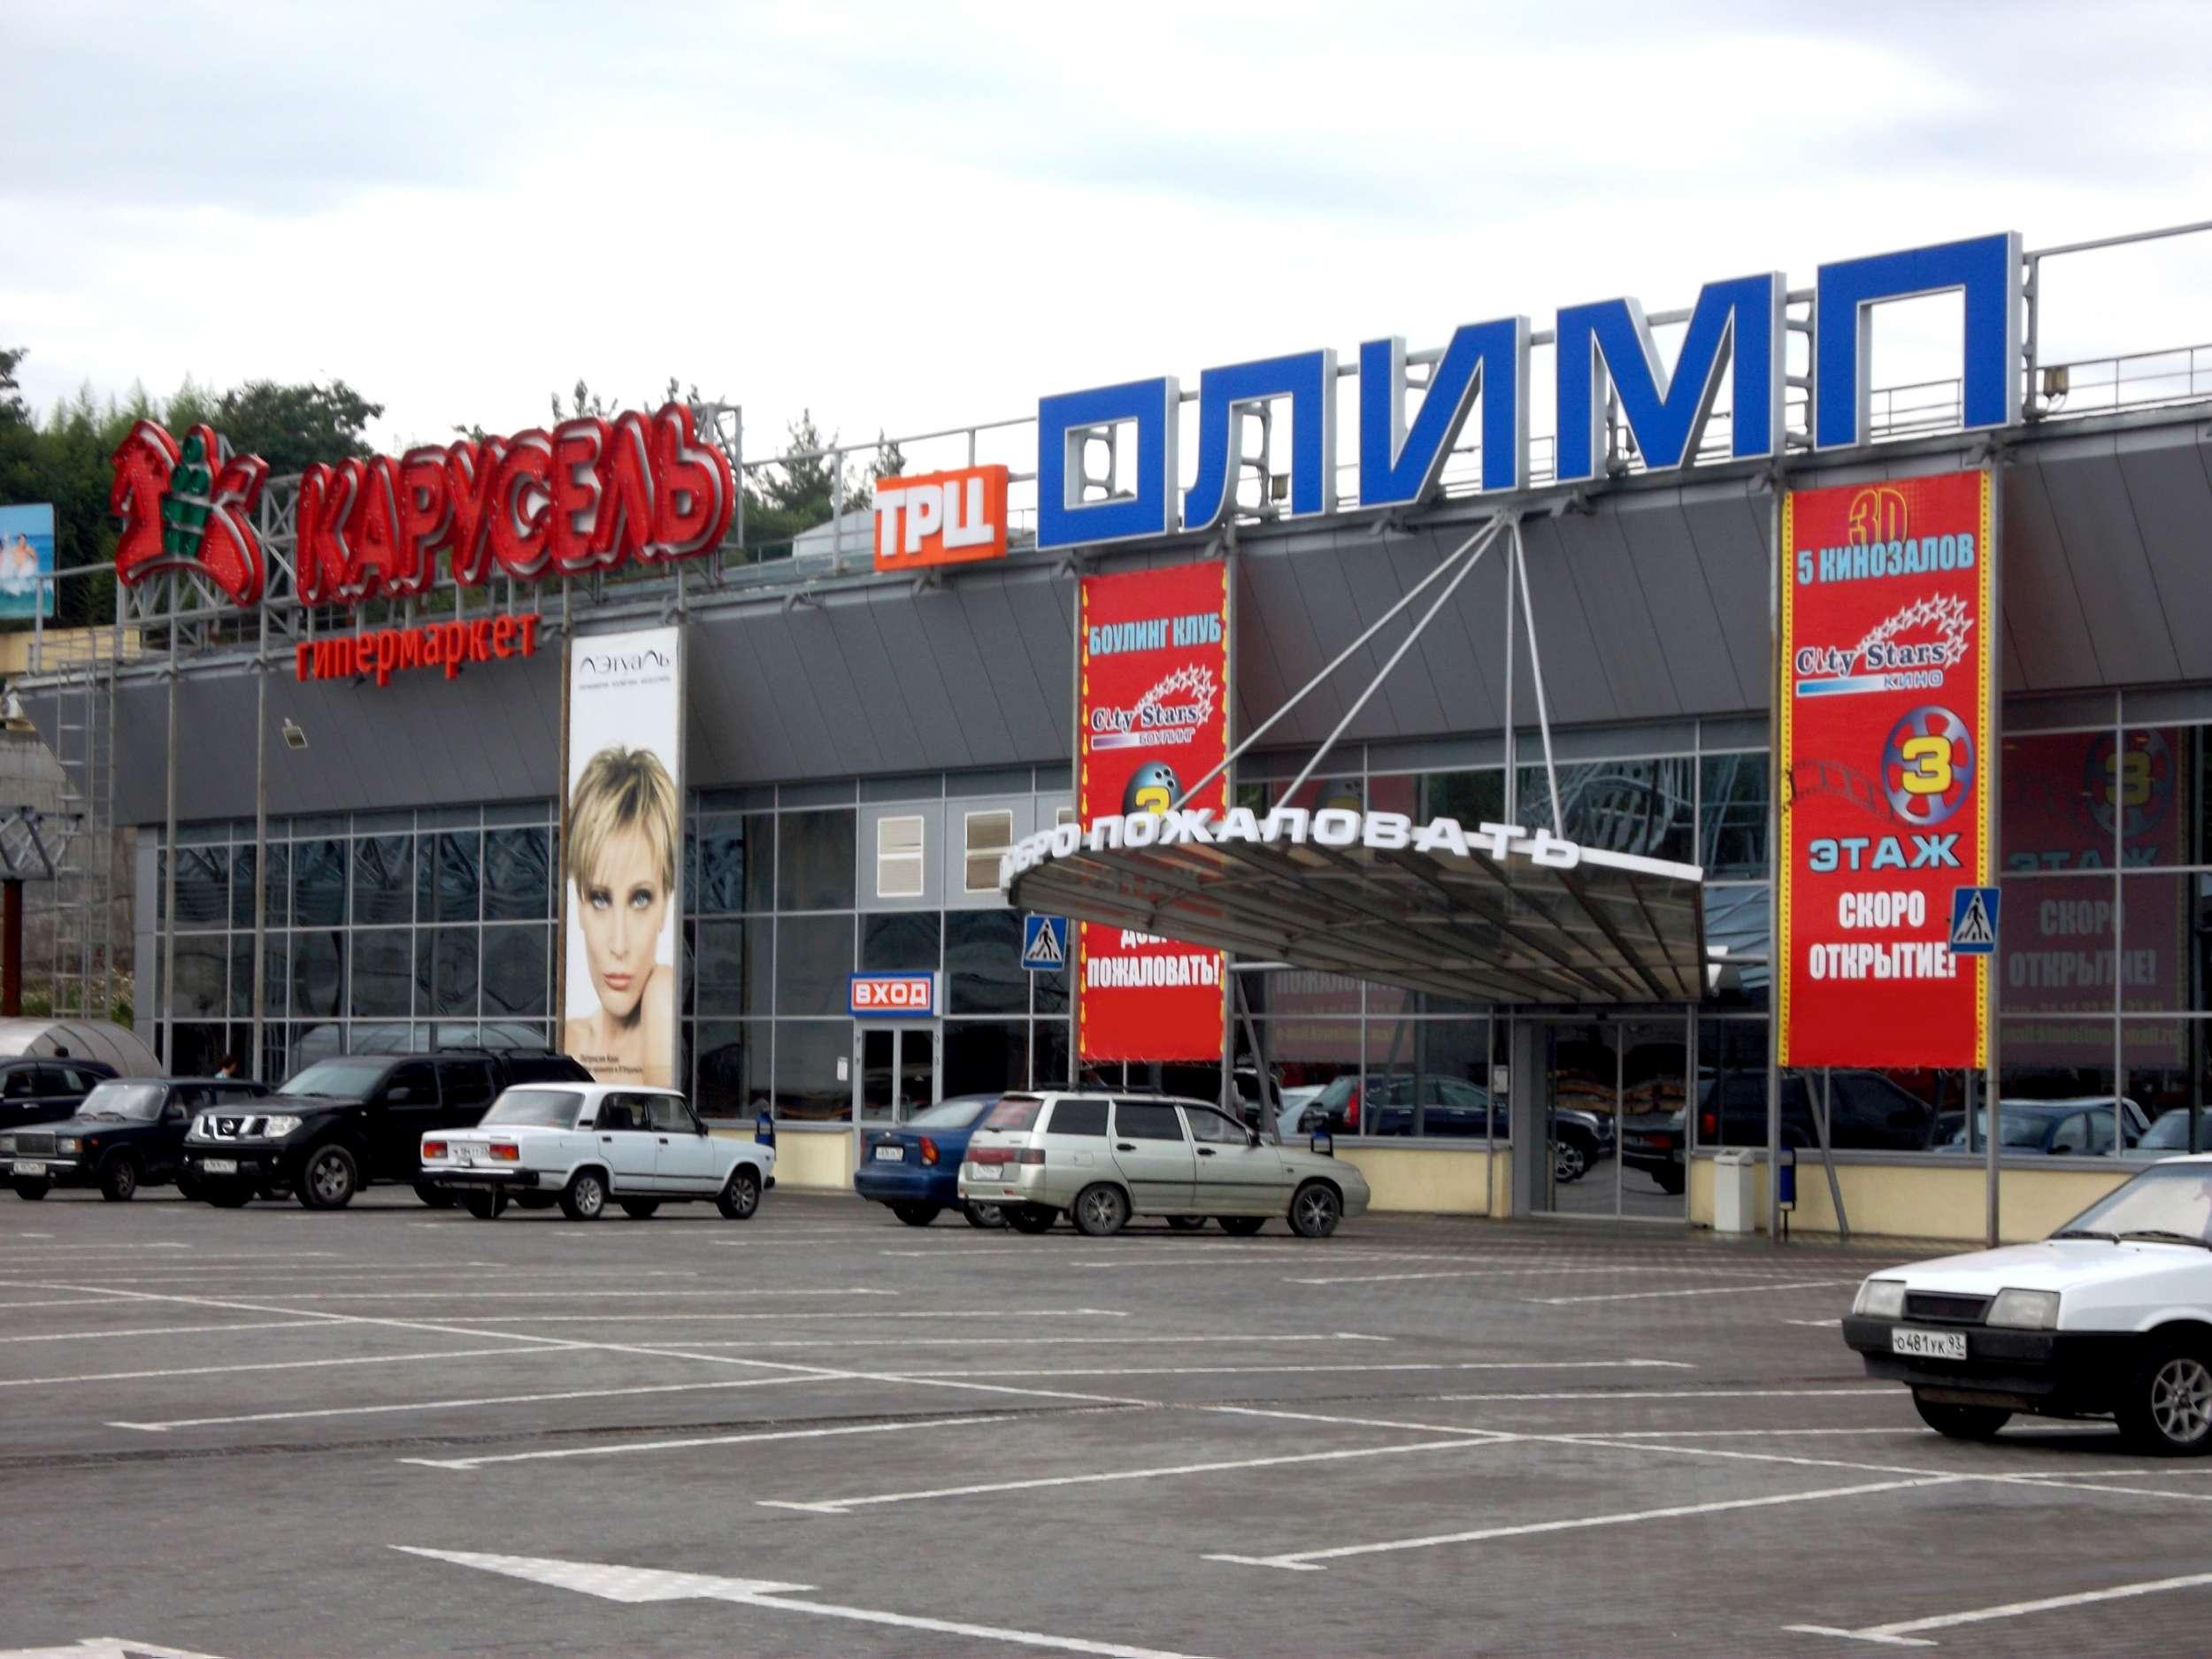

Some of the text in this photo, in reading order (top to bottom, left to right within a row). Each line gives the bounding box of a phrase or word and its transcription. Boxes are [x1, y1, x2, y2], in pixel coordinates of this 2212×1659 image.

[872, 230, 2023, 557] ТРЦ ОЛИМП
[296, 403, 735, 607] КАРУСЕЛЬ
[1797, 533, 1976, 585] 5 КИНОЗАЛОВ
[296, 613, 541, 687] гипермаркет
[1089, 612, 1222, 656] БОУЛИНГ КЛУБ
[1796, 642, 1947, 677] City Stars
[1883, 670, 1944, 688] КИНО
[1091, 703, 1199, 733] City Stars
[1901, 735, 1953, 795] 3
[1091, 807, 1581, 870] ПОЖАЛОВАТЬ
[1809, 833, 1962, 872] ЭТАЖ
[1838, 890, 1926, 928] СКОРО
[1087, 954, 1219, 987] ПОЖАЛОВАТЬ!
[1809, 941, 1956, 979] ОТКРЫТИЕ!
[855, 982, 927, 1006] ВХОД
